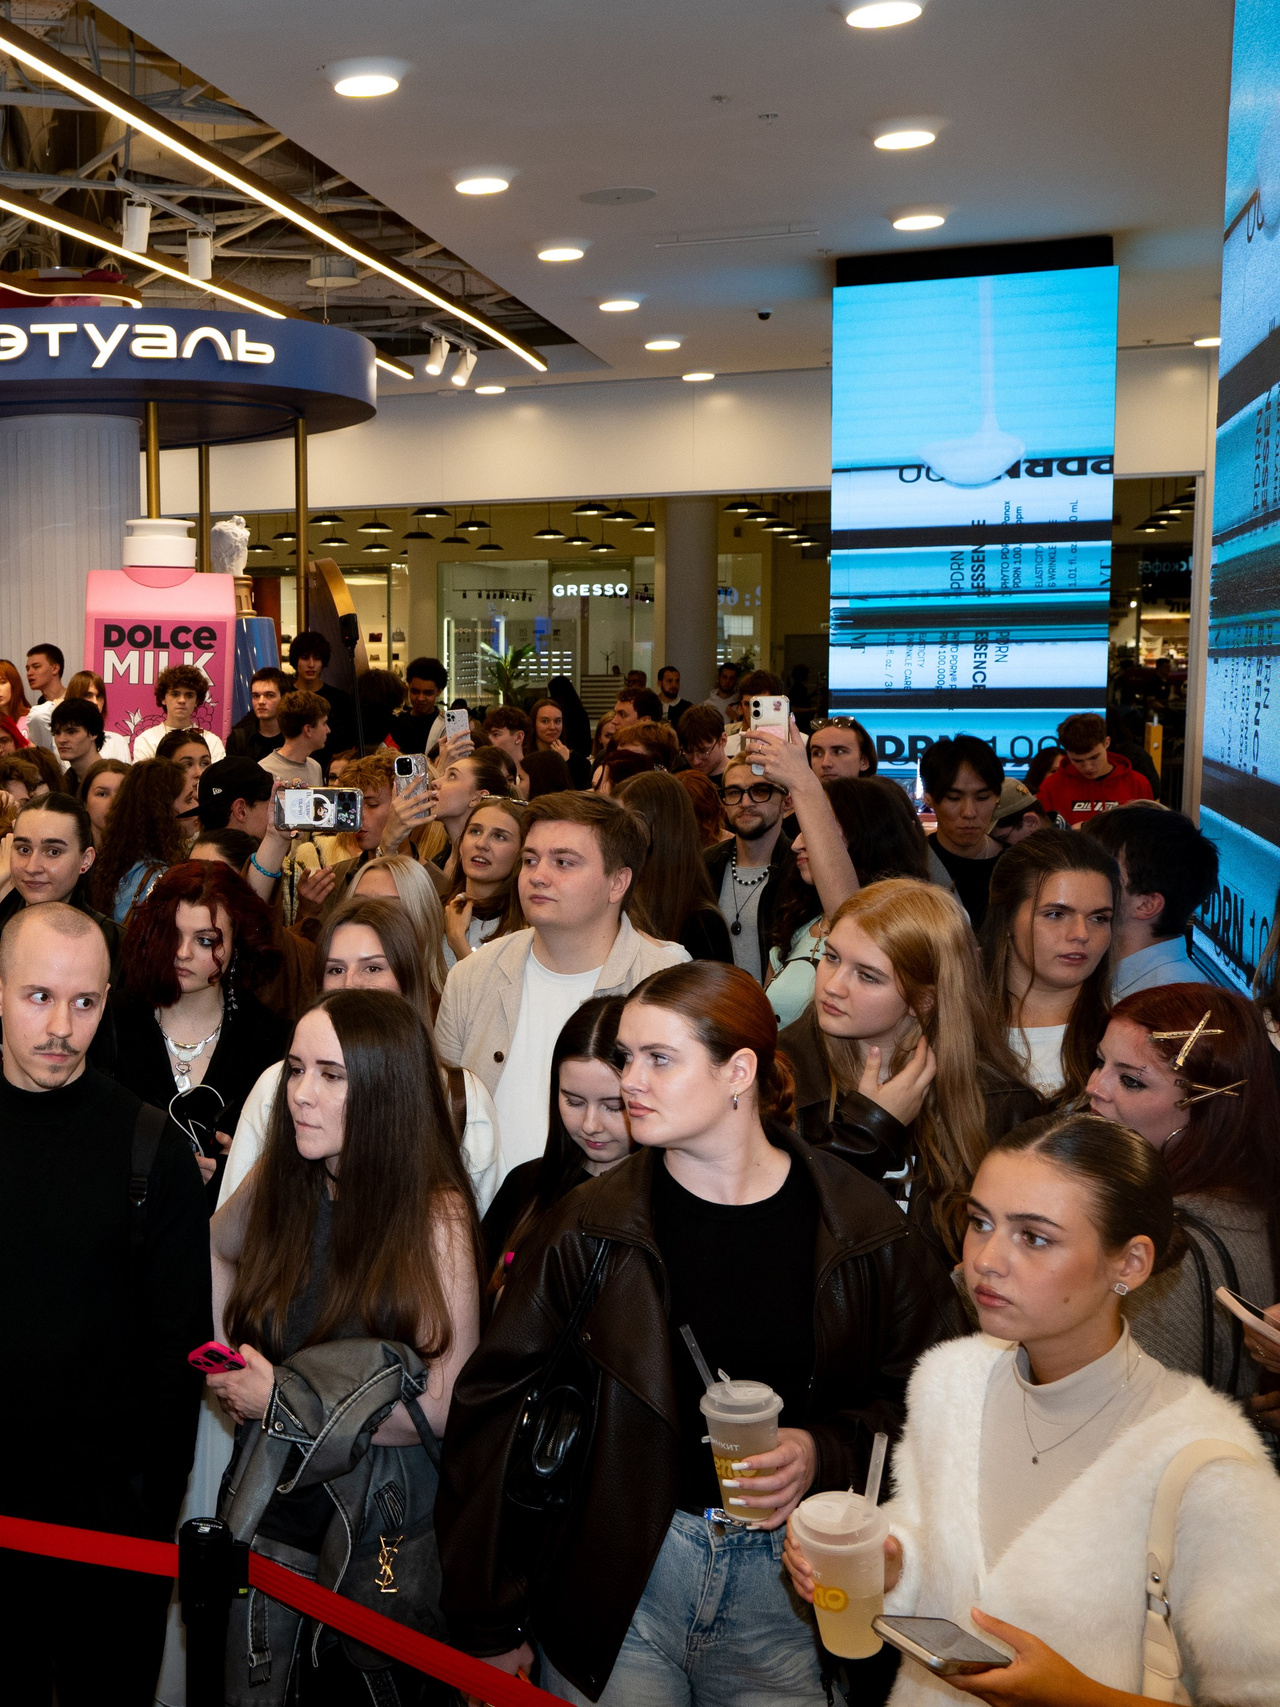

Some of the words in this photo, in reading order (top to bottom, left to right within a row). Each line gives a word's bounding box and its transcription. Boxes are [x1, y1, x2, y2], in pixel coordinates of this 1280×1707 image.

[950, 550, 965, 590] PDRN
[971, 519, 987, 591] ESSENE
[552, 583, 628, 597] GRESSO
